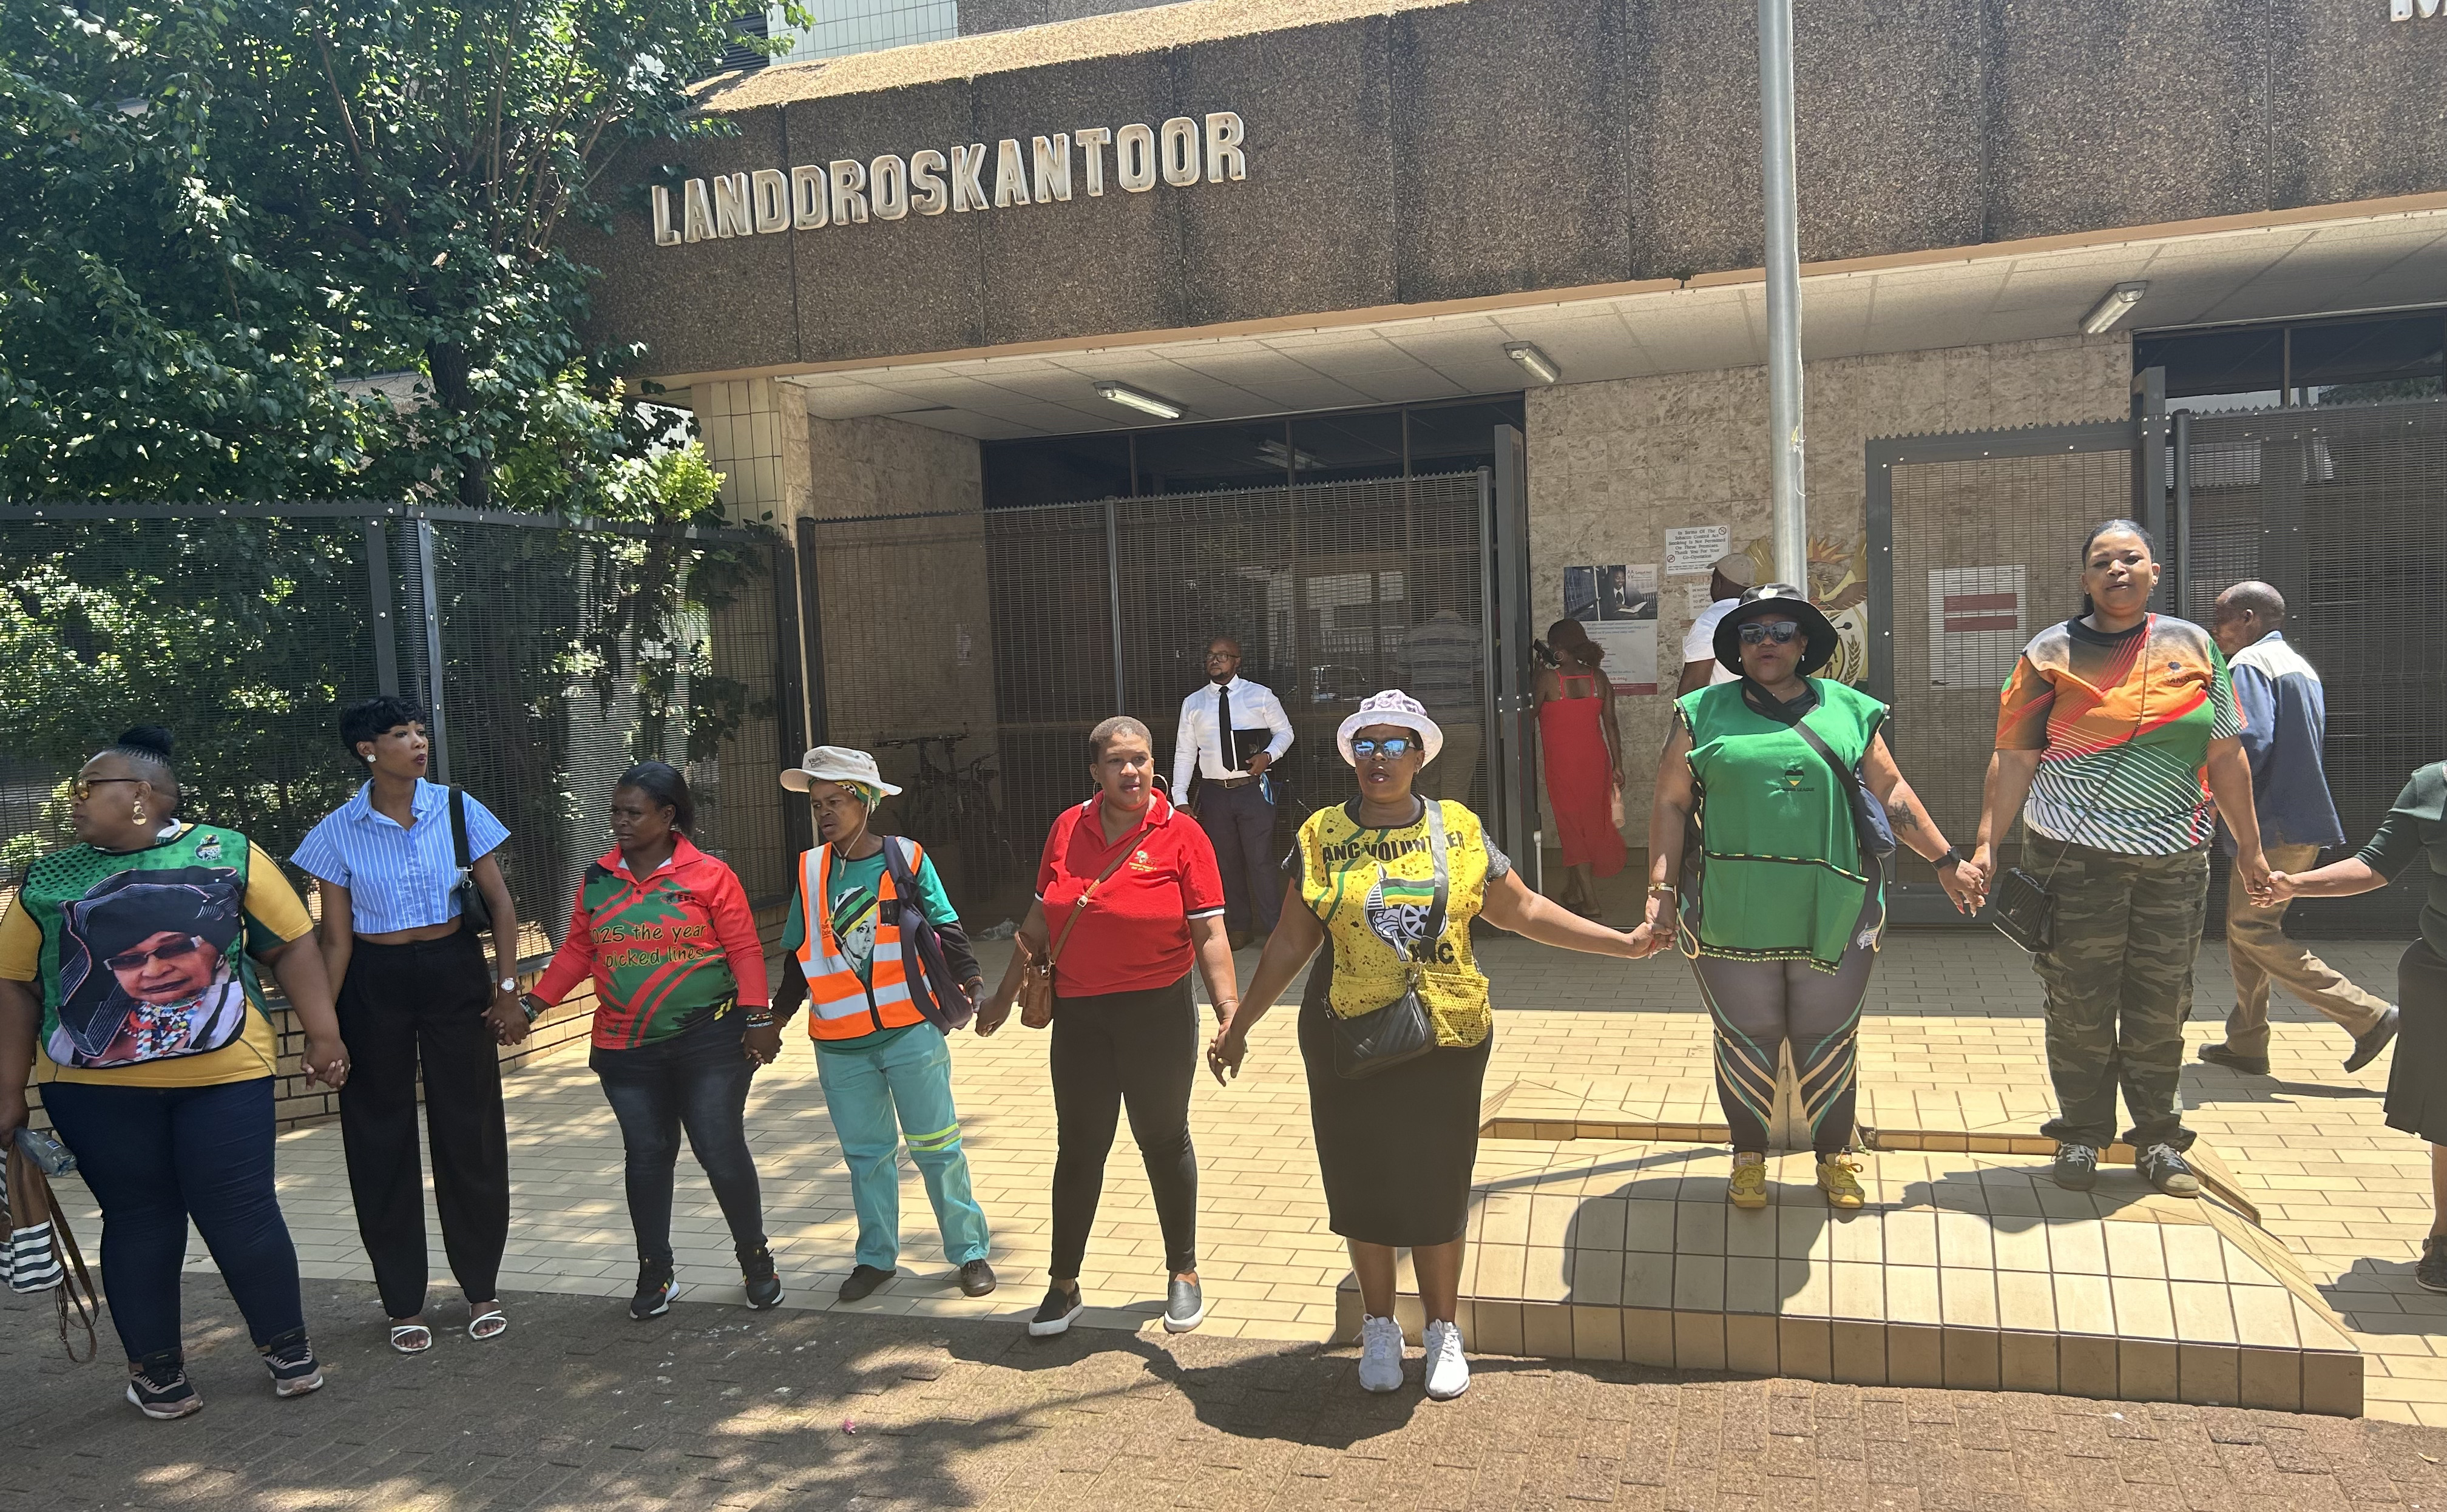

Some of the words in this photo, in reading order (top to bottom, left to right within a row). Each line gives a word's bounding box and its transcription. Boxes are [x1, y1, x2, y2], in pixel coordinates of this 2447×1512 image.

[651, 111, 1245, 246] LANDDROSKANTOOR
[1322, 842, 1361, 865] ANC
[590, 925, 626, 945] 025
[632, 923, 663, 941] the
[671, 925, 706, 944] year
[604, 947, 661, 968] picked
[668, 945, 705, 963] lines
